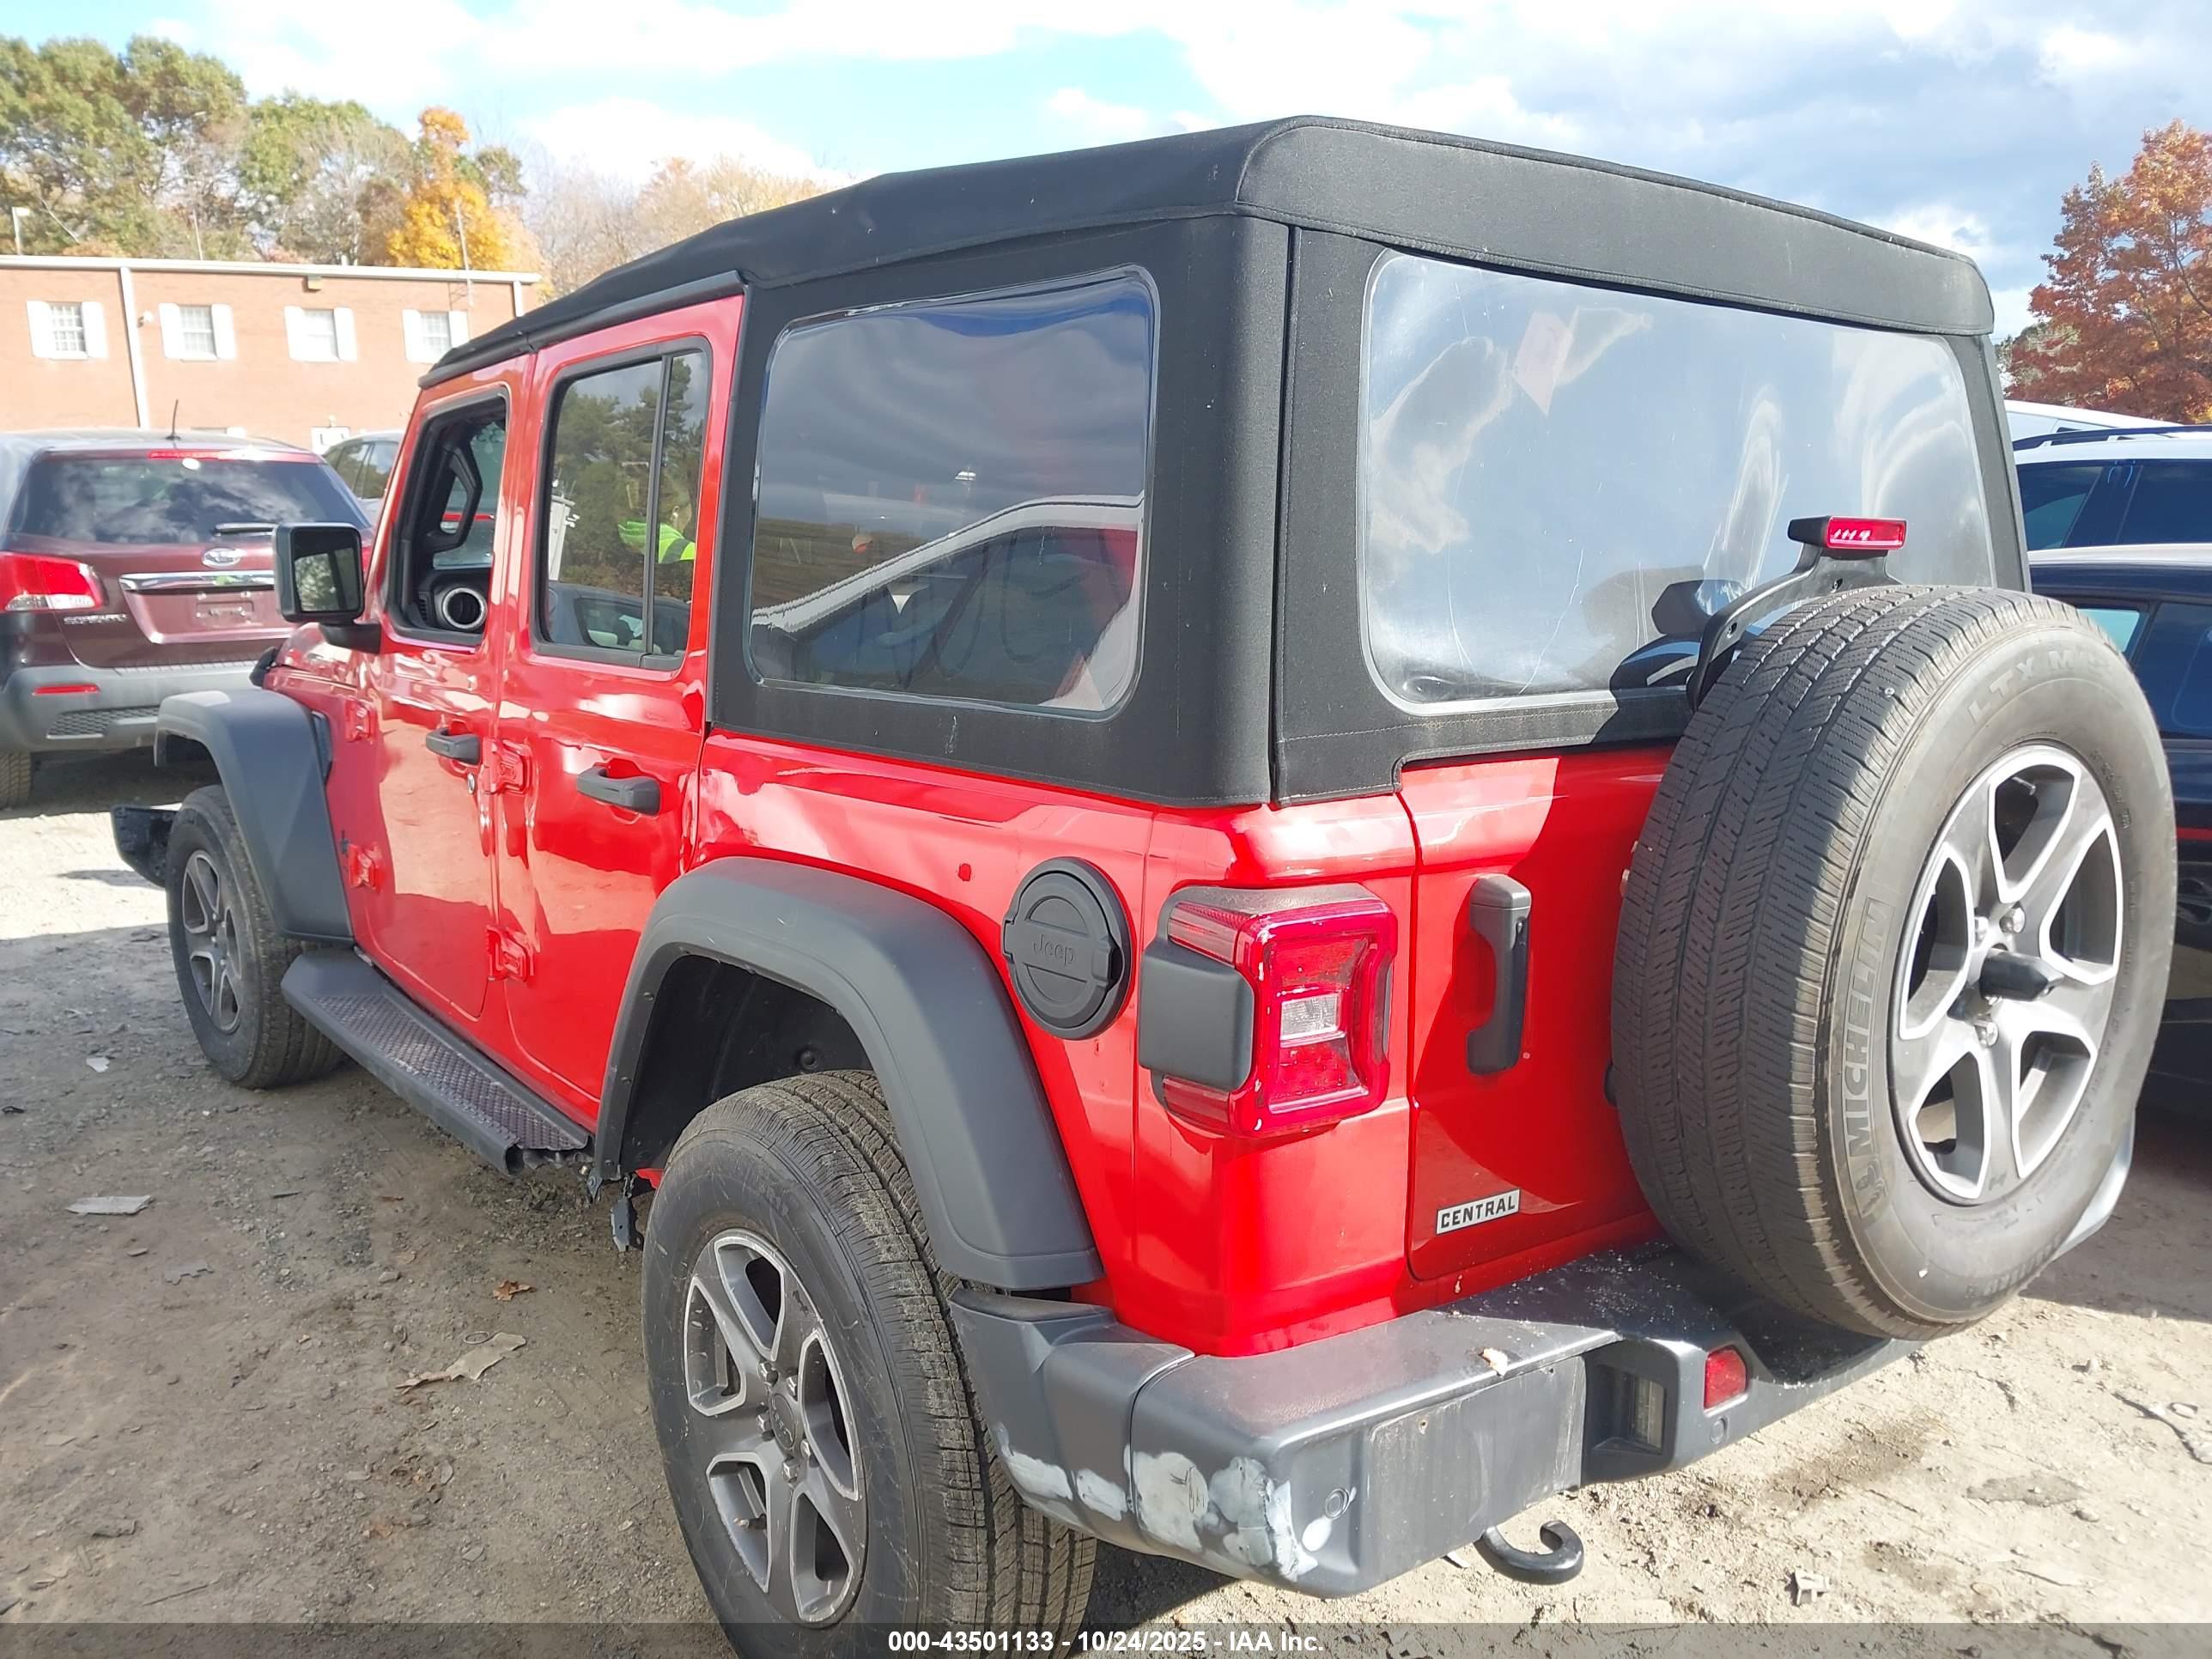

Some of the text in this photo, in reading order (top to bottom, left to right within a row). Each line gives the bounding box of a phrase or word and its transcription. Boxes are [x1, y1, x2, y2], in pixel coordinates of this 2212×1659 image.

[1033, 933, 1075, 967] Jeep
[1844, 897, 1893, 1158] MICHELIN
[1440, 1194, 1516, 1230] CENTRAL
